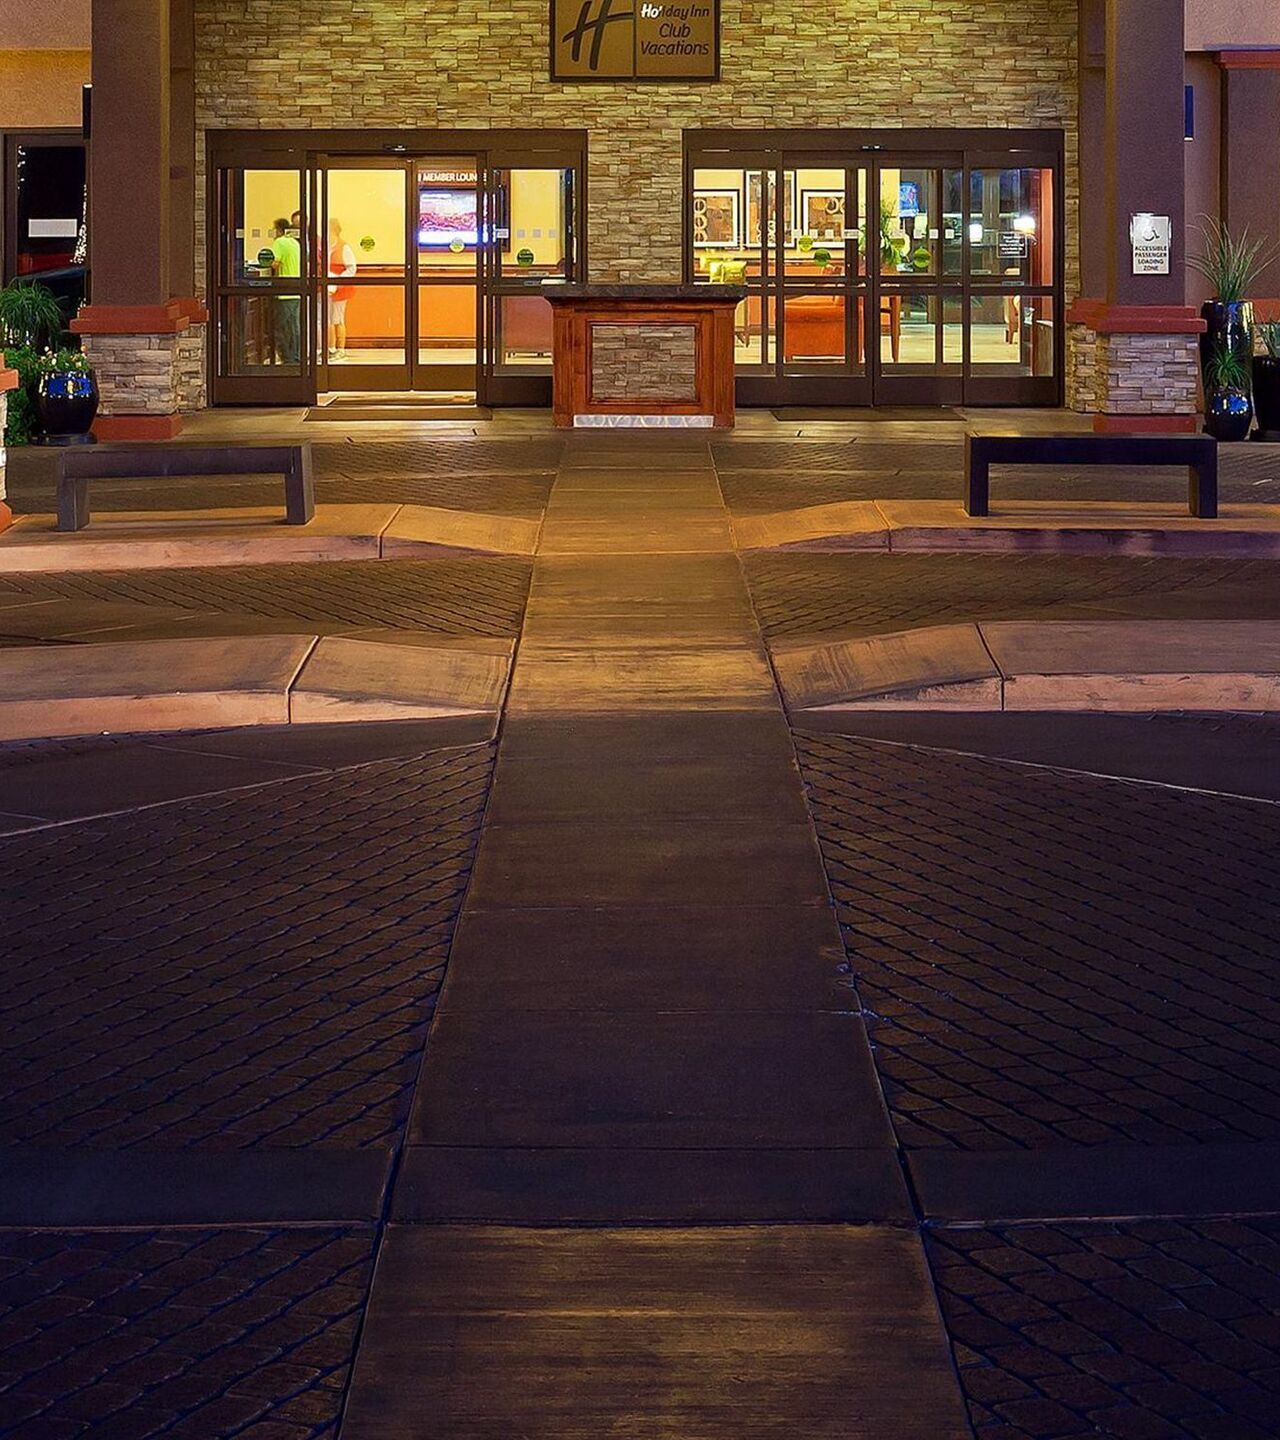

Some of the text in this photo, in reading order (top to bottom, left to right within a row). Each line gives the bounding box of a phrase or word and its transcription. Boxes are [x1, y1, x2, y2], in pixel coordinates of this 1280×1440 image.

[690, 4, 710, 17] Inn
[659, 23, 691, 38] Club
[640, 40, 710, 56] Vacations
[422, 172, 455, 182] MEMBER
[455, 172, 487, 182] LOUN
